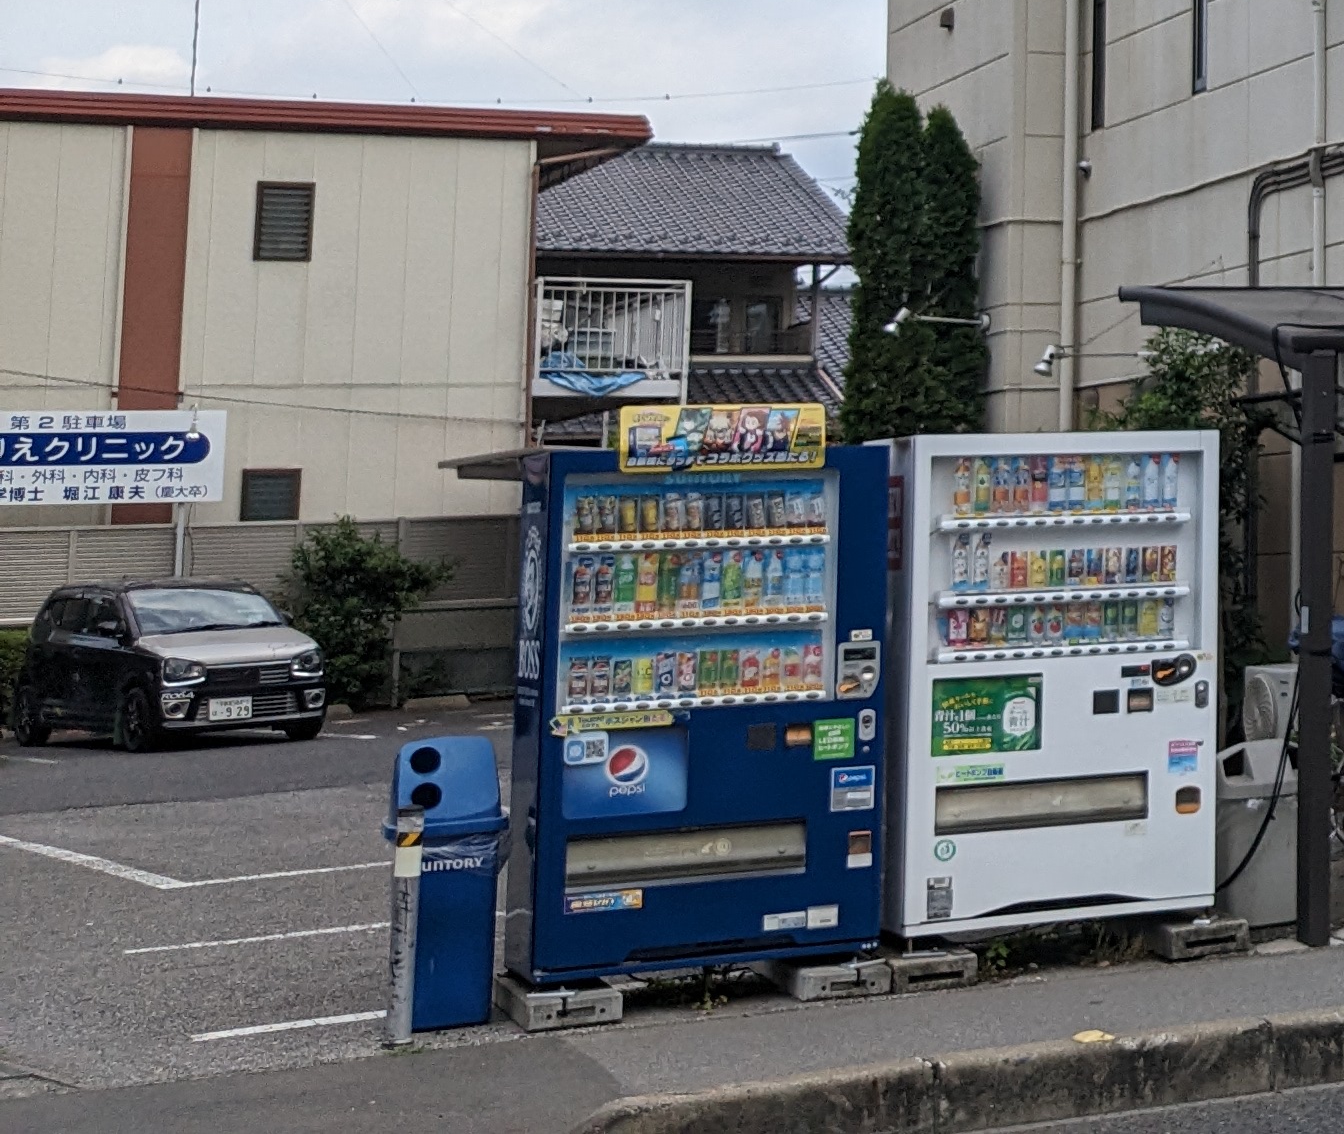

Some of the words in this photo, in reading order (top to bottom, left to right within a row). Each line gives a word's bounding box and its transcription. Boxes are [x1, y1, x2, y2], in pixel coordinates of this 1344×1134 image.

[10, 415, 127, 431] 第2駐車場
[421, 856, 485, 873] UNTORY
